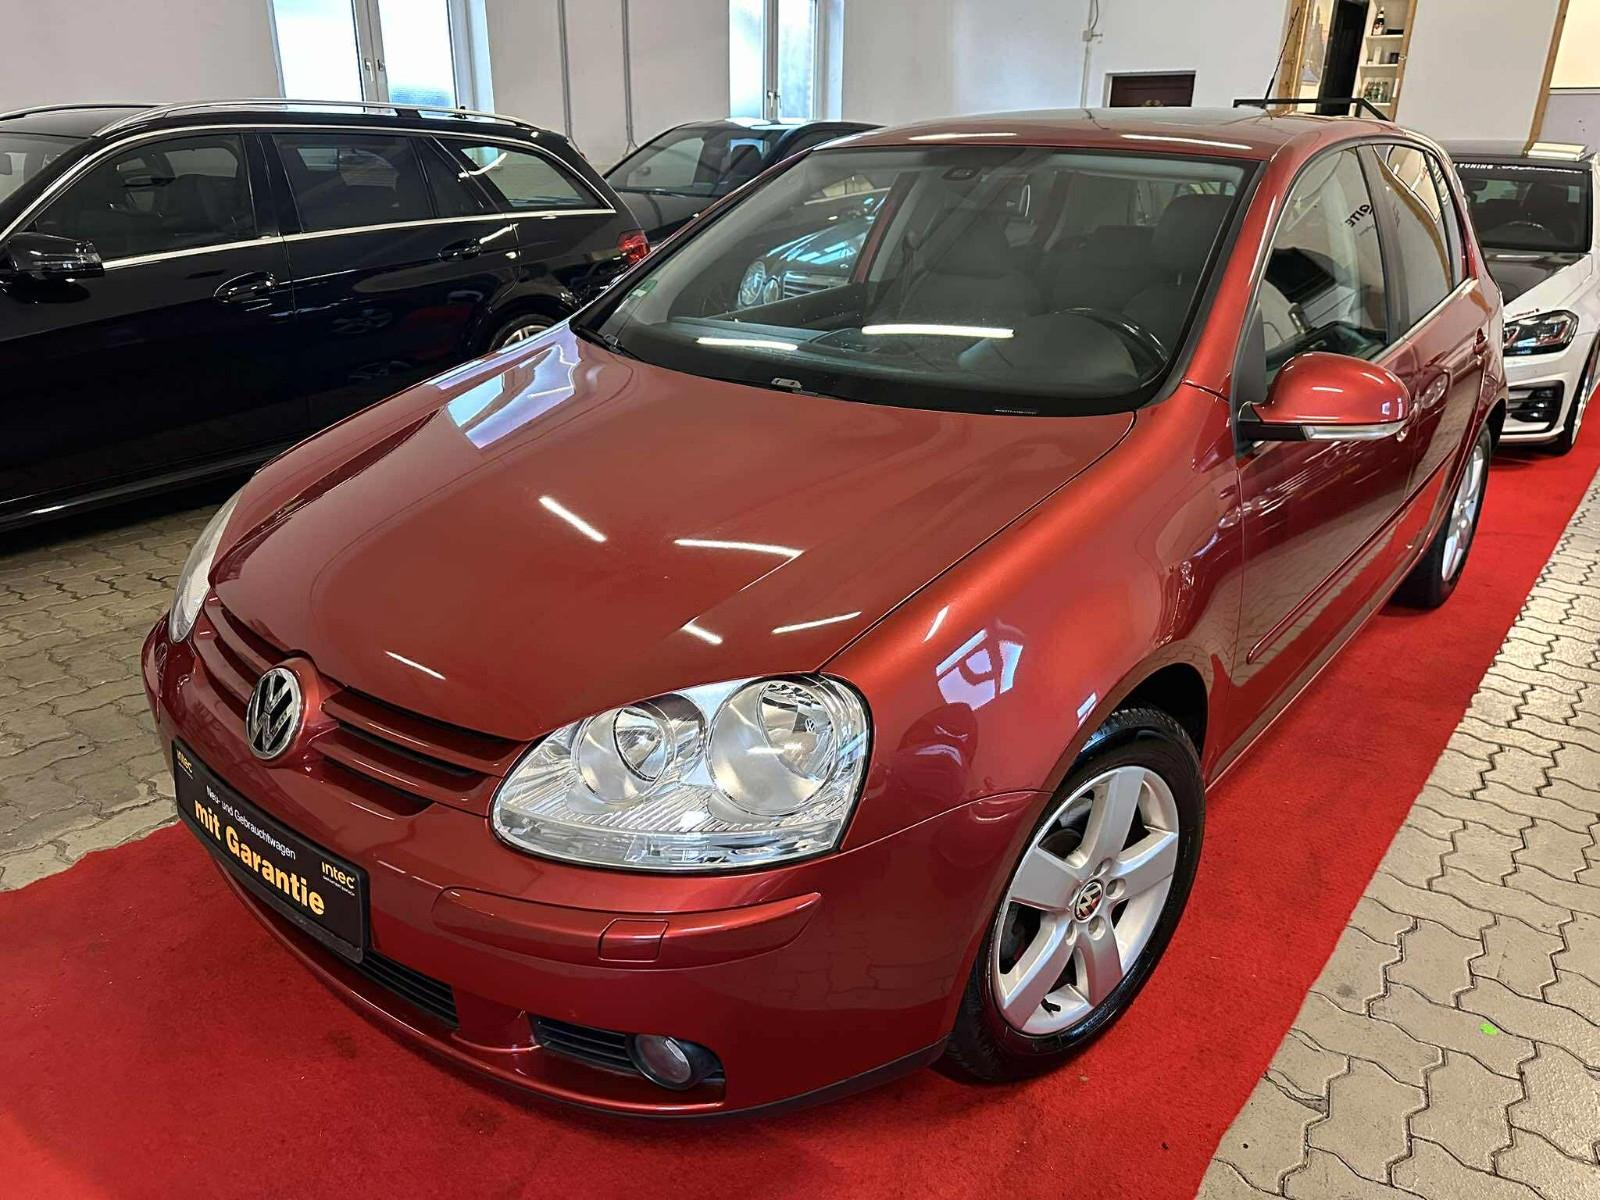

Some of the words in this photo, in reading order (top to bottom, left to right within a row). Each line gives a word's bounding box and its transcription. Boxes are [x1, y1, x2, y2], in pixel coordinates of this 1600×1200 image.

[194, 799, 221, 841] mit
[226, 825, 324, 916] Garantie
[206, 785, 220, 804] Neu-
[221, 800, 234, 816] und
[234, 809, 296, 860] Gebrauchtwagen
